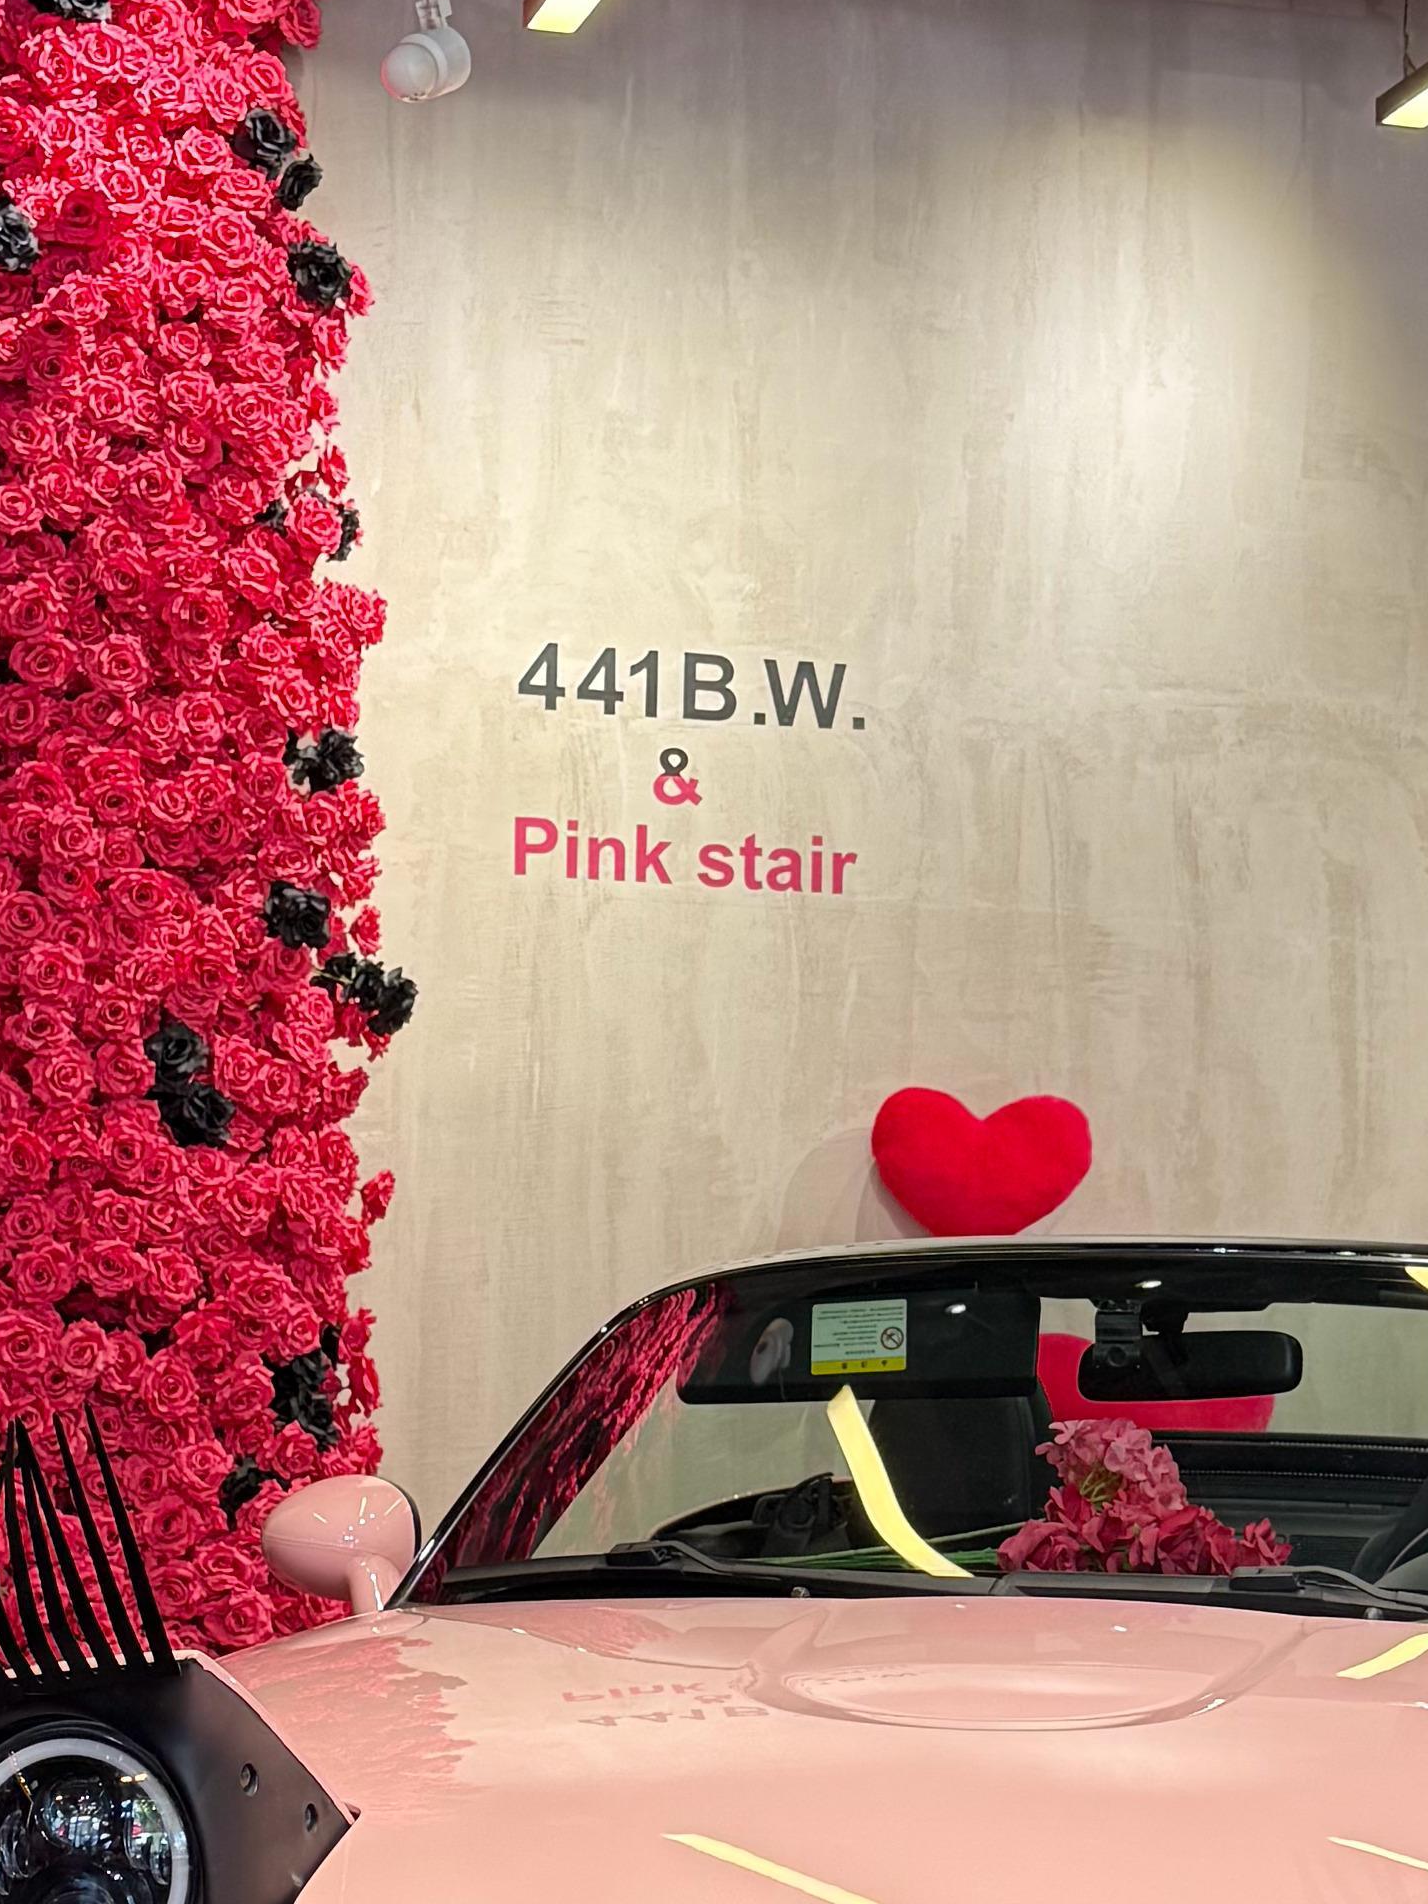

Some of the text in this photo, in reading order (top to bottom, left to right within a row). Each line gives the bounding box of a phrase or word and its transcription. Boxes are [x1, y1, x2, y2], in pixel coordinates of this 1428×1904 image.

[517, 642, 865, 730] 441B.W.
[653, 747, 703, 806] &
[514, 816, 858, 895] Pink stair
